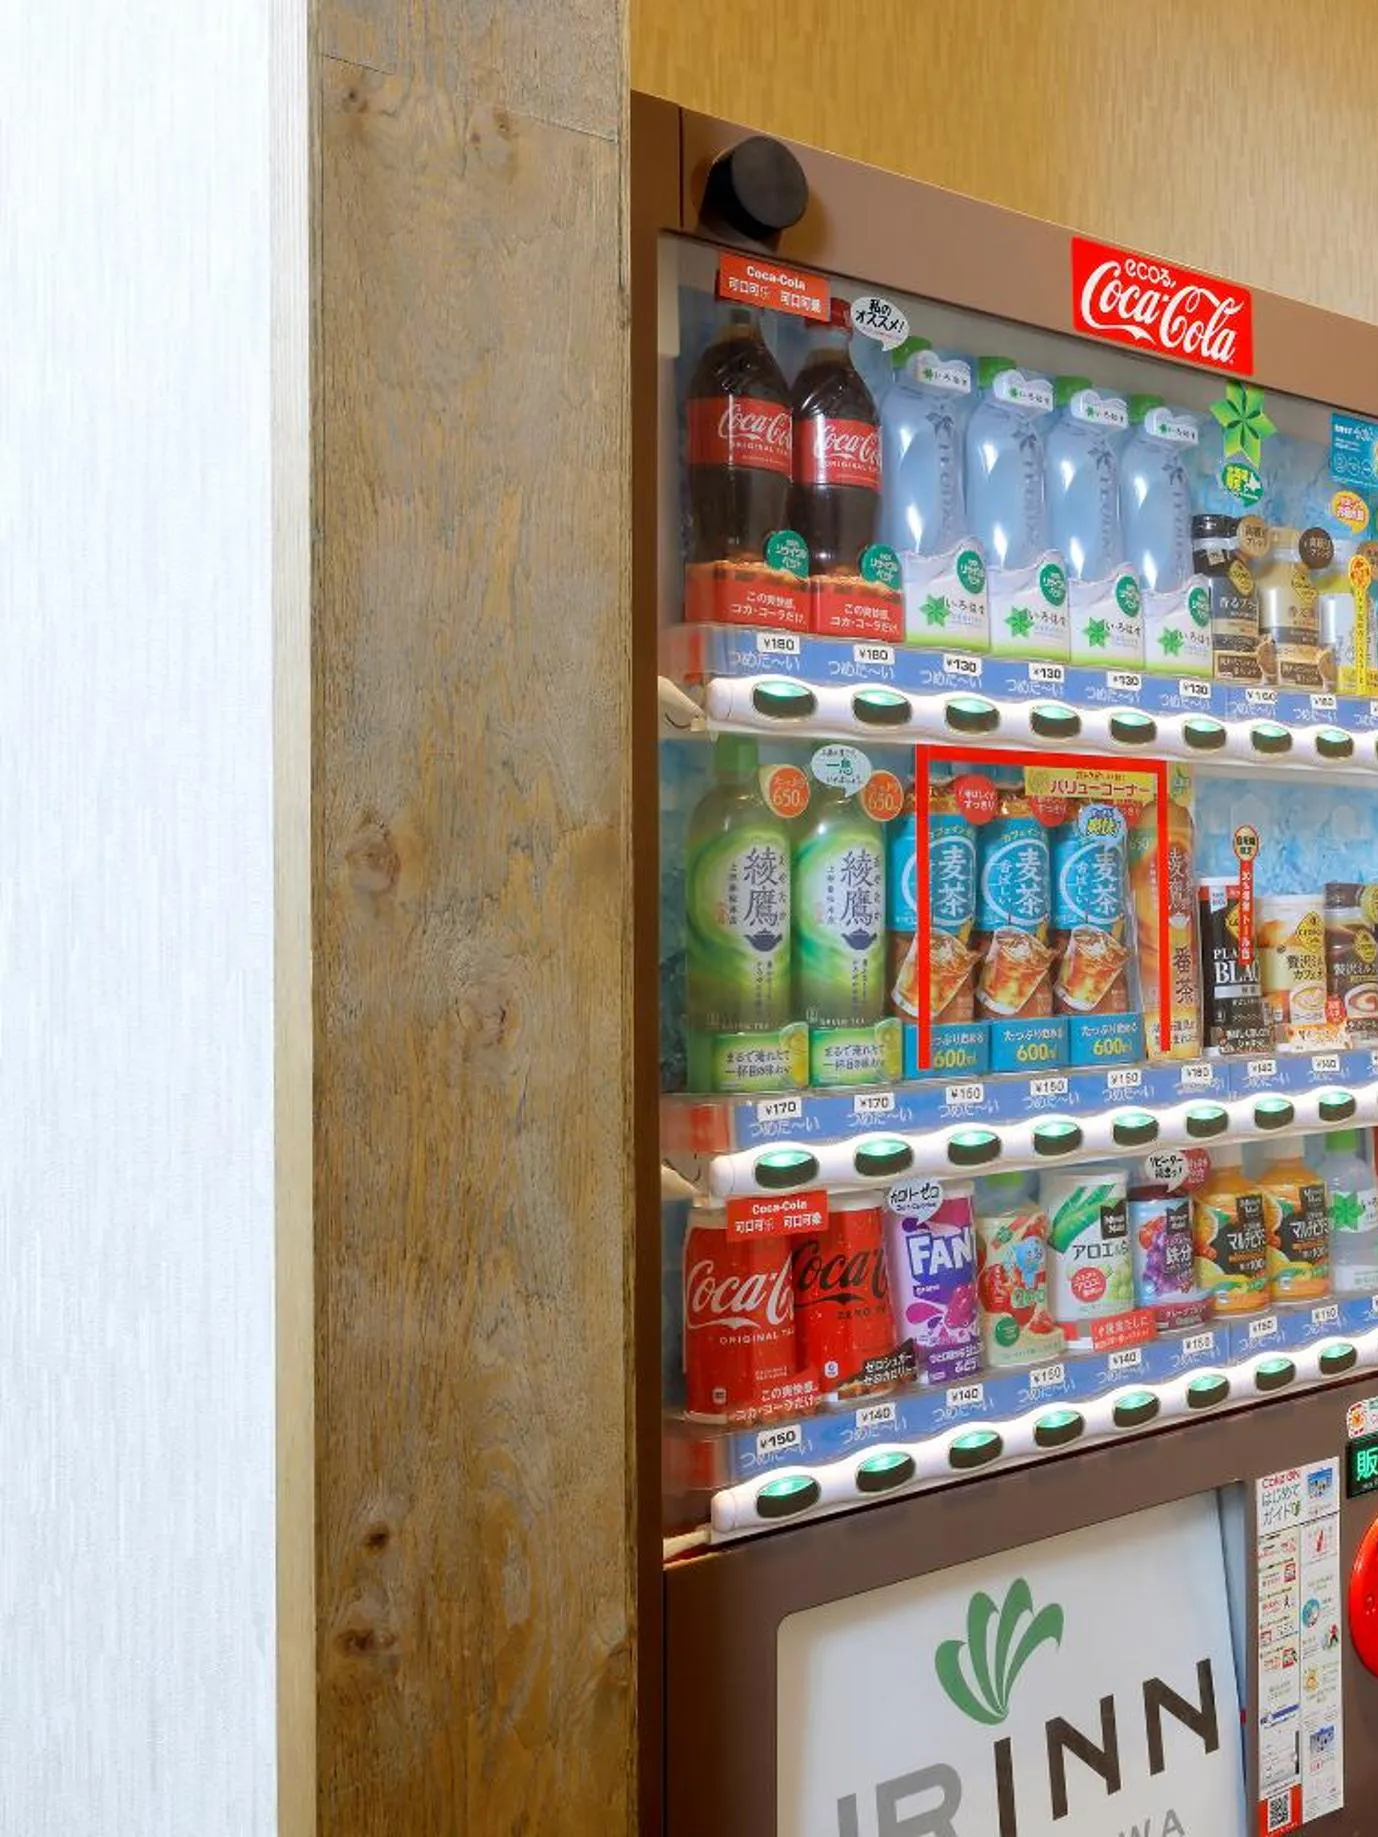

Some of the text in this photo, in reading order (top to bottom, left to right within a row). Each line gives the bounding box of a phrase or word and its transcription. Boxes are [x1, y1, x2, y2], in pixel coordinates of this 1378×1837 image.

[747, 265, 806, 291] Coca-Cola
[869, 299, 892, 316] 私の
[1081, 261, 1244, 364] Coca-Cola
[764, 638, 796, 650] ¥180
[947, 659, 977, 673] ¥130
[1034, 668, 1062, 679] ¥130
[744, 846, 779, 927] 綾鷹
[839, 848, 874, 927] 綾鷹
[937, 846, 969, 917] 麦茶
[1015, 849, 1044, 917] 麦茶
[1094, 849, 1118, 916] 麦茶
[1213, 948, 1238, 960] PLA
[1173, 947, 1195, 1005] 番茶
[765, 1101, 796, 1116] ¥170
[859, 1097, 889, 1109] ¥170
[752, 1200, 807, 1215] Coca-Cola
[907, 1223, 975, 1275] FAN
[719, 1332, 779, 1345] ORIGINAL
[952, 1388, 979, 1401] ¥140
[760, 1430, 797, 1449] ¥150
[994, 1658, 1220, 1837] INN
